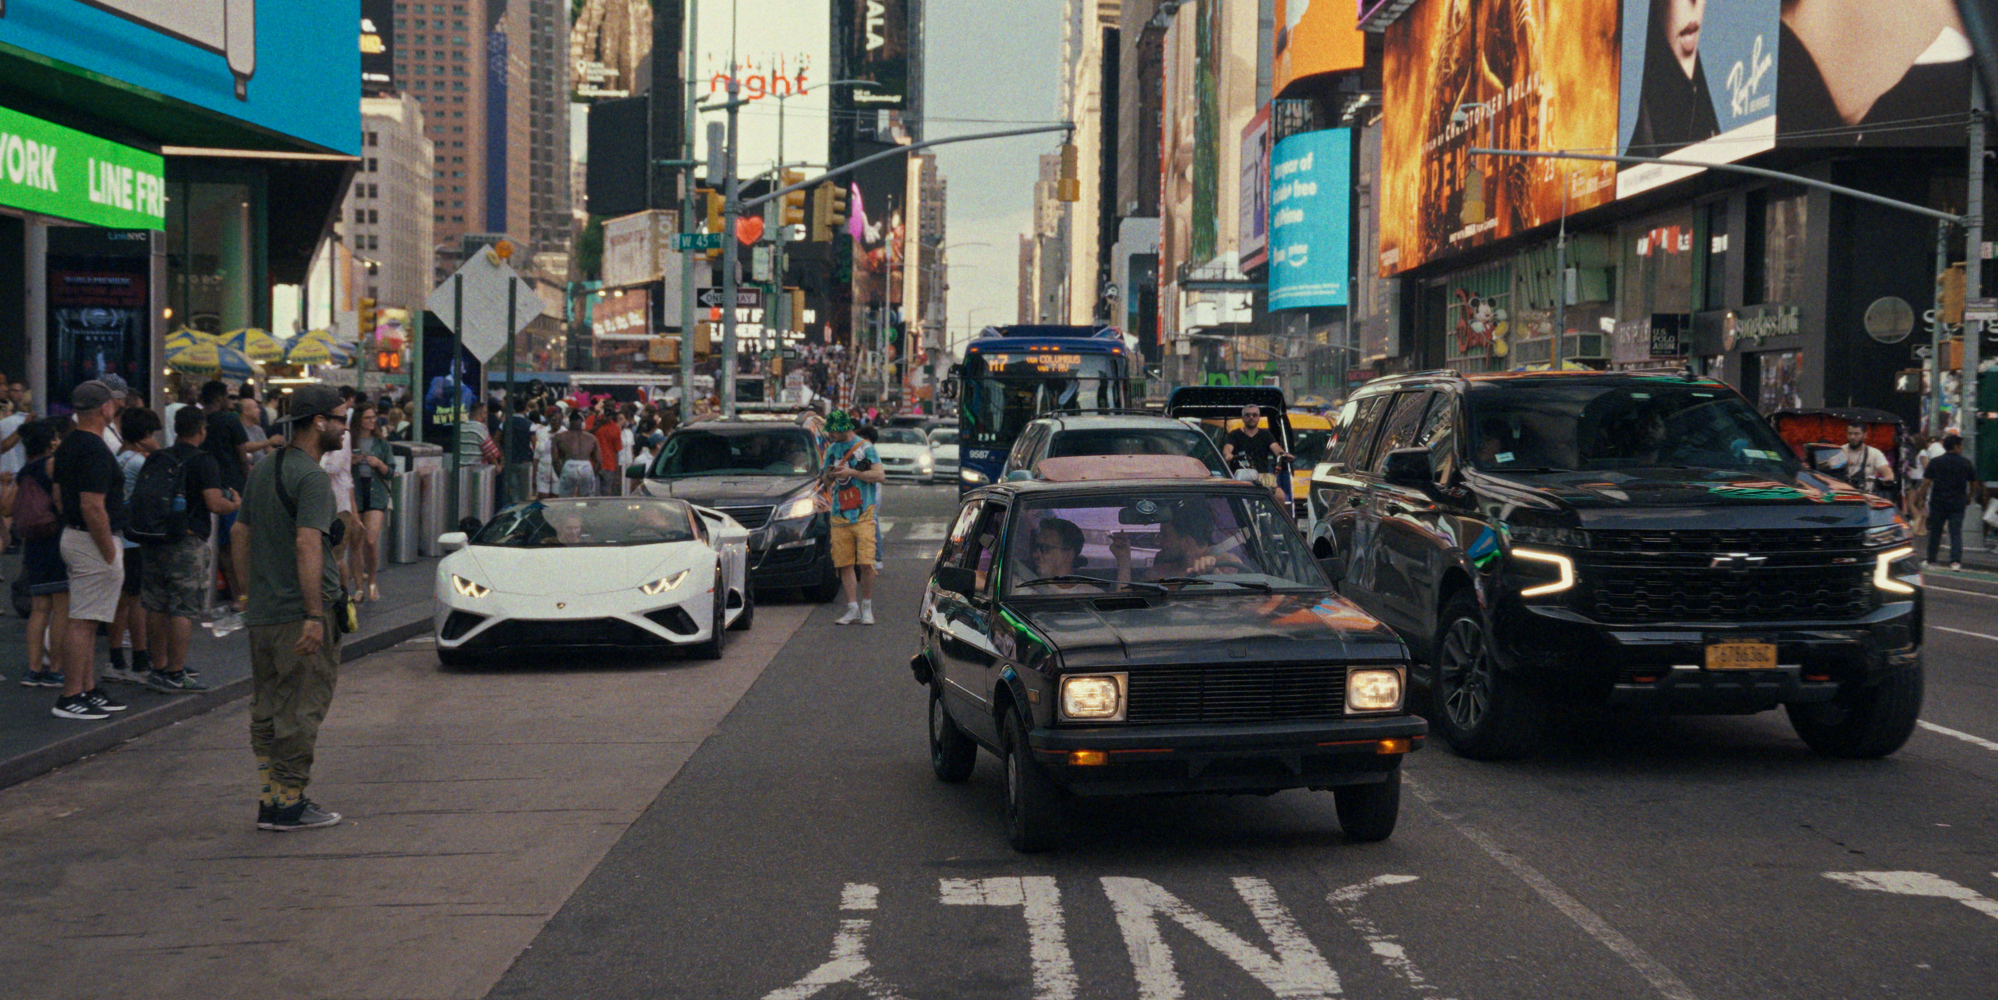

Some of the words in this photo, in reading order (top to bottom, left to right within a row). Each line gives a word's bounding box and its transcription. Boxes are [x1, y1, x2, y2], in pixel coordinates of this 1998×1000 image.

[89, 157, 134, 211] LINE
[682, 235, 692, 247] W
[696, 235, 709, 247] 45
[1039, 354, 1081, 365] COLUMBUS
[969, 450, 989, 459] 9587
